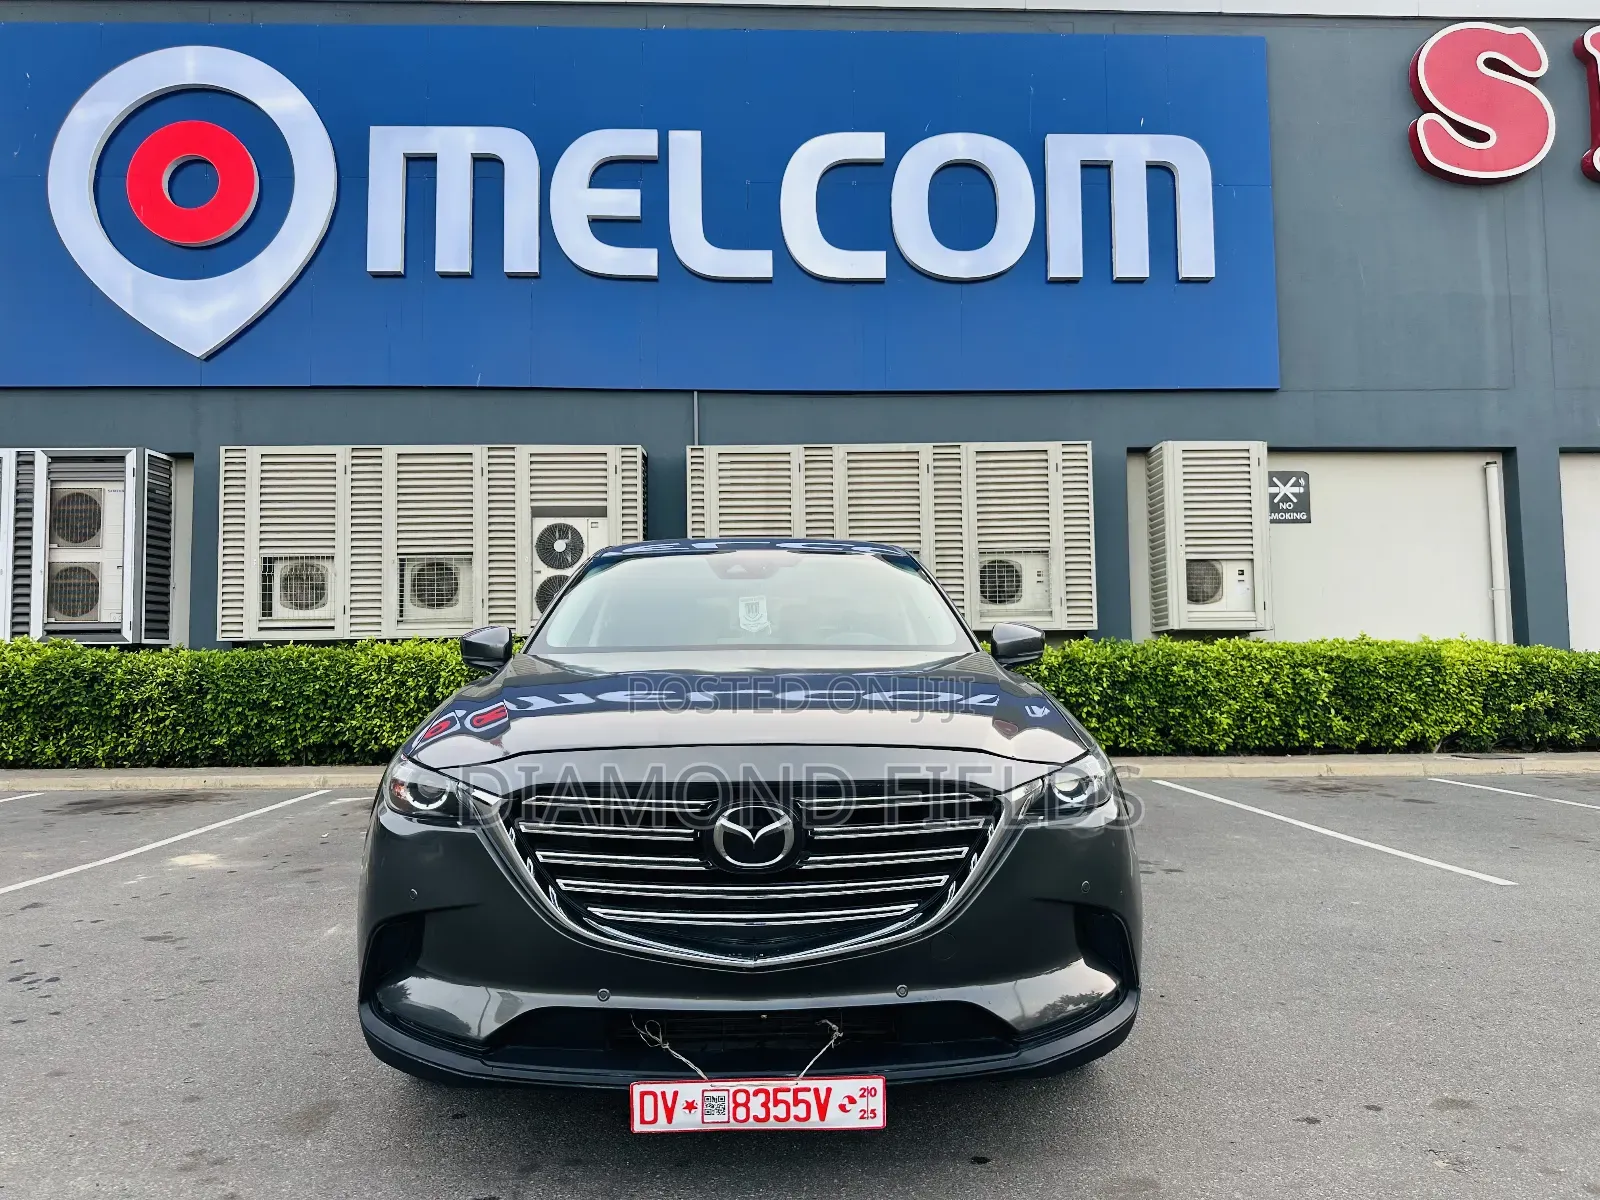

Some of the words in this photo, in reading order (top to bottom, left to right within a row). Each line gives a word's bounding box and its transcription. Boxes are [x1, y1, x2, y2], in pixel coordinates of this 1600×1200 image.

[1409, 21, 1600, 186] S
[366, 125, 1216, 280] MELCOM
[1279, 502, 1294, 510] NO
[859, 1087, 877, 1098] 20
[639, 1090, 679, 1124] DV
[732, 1087, 832, 1122] 8355V
[859, 1109, 877, 1119] 25
